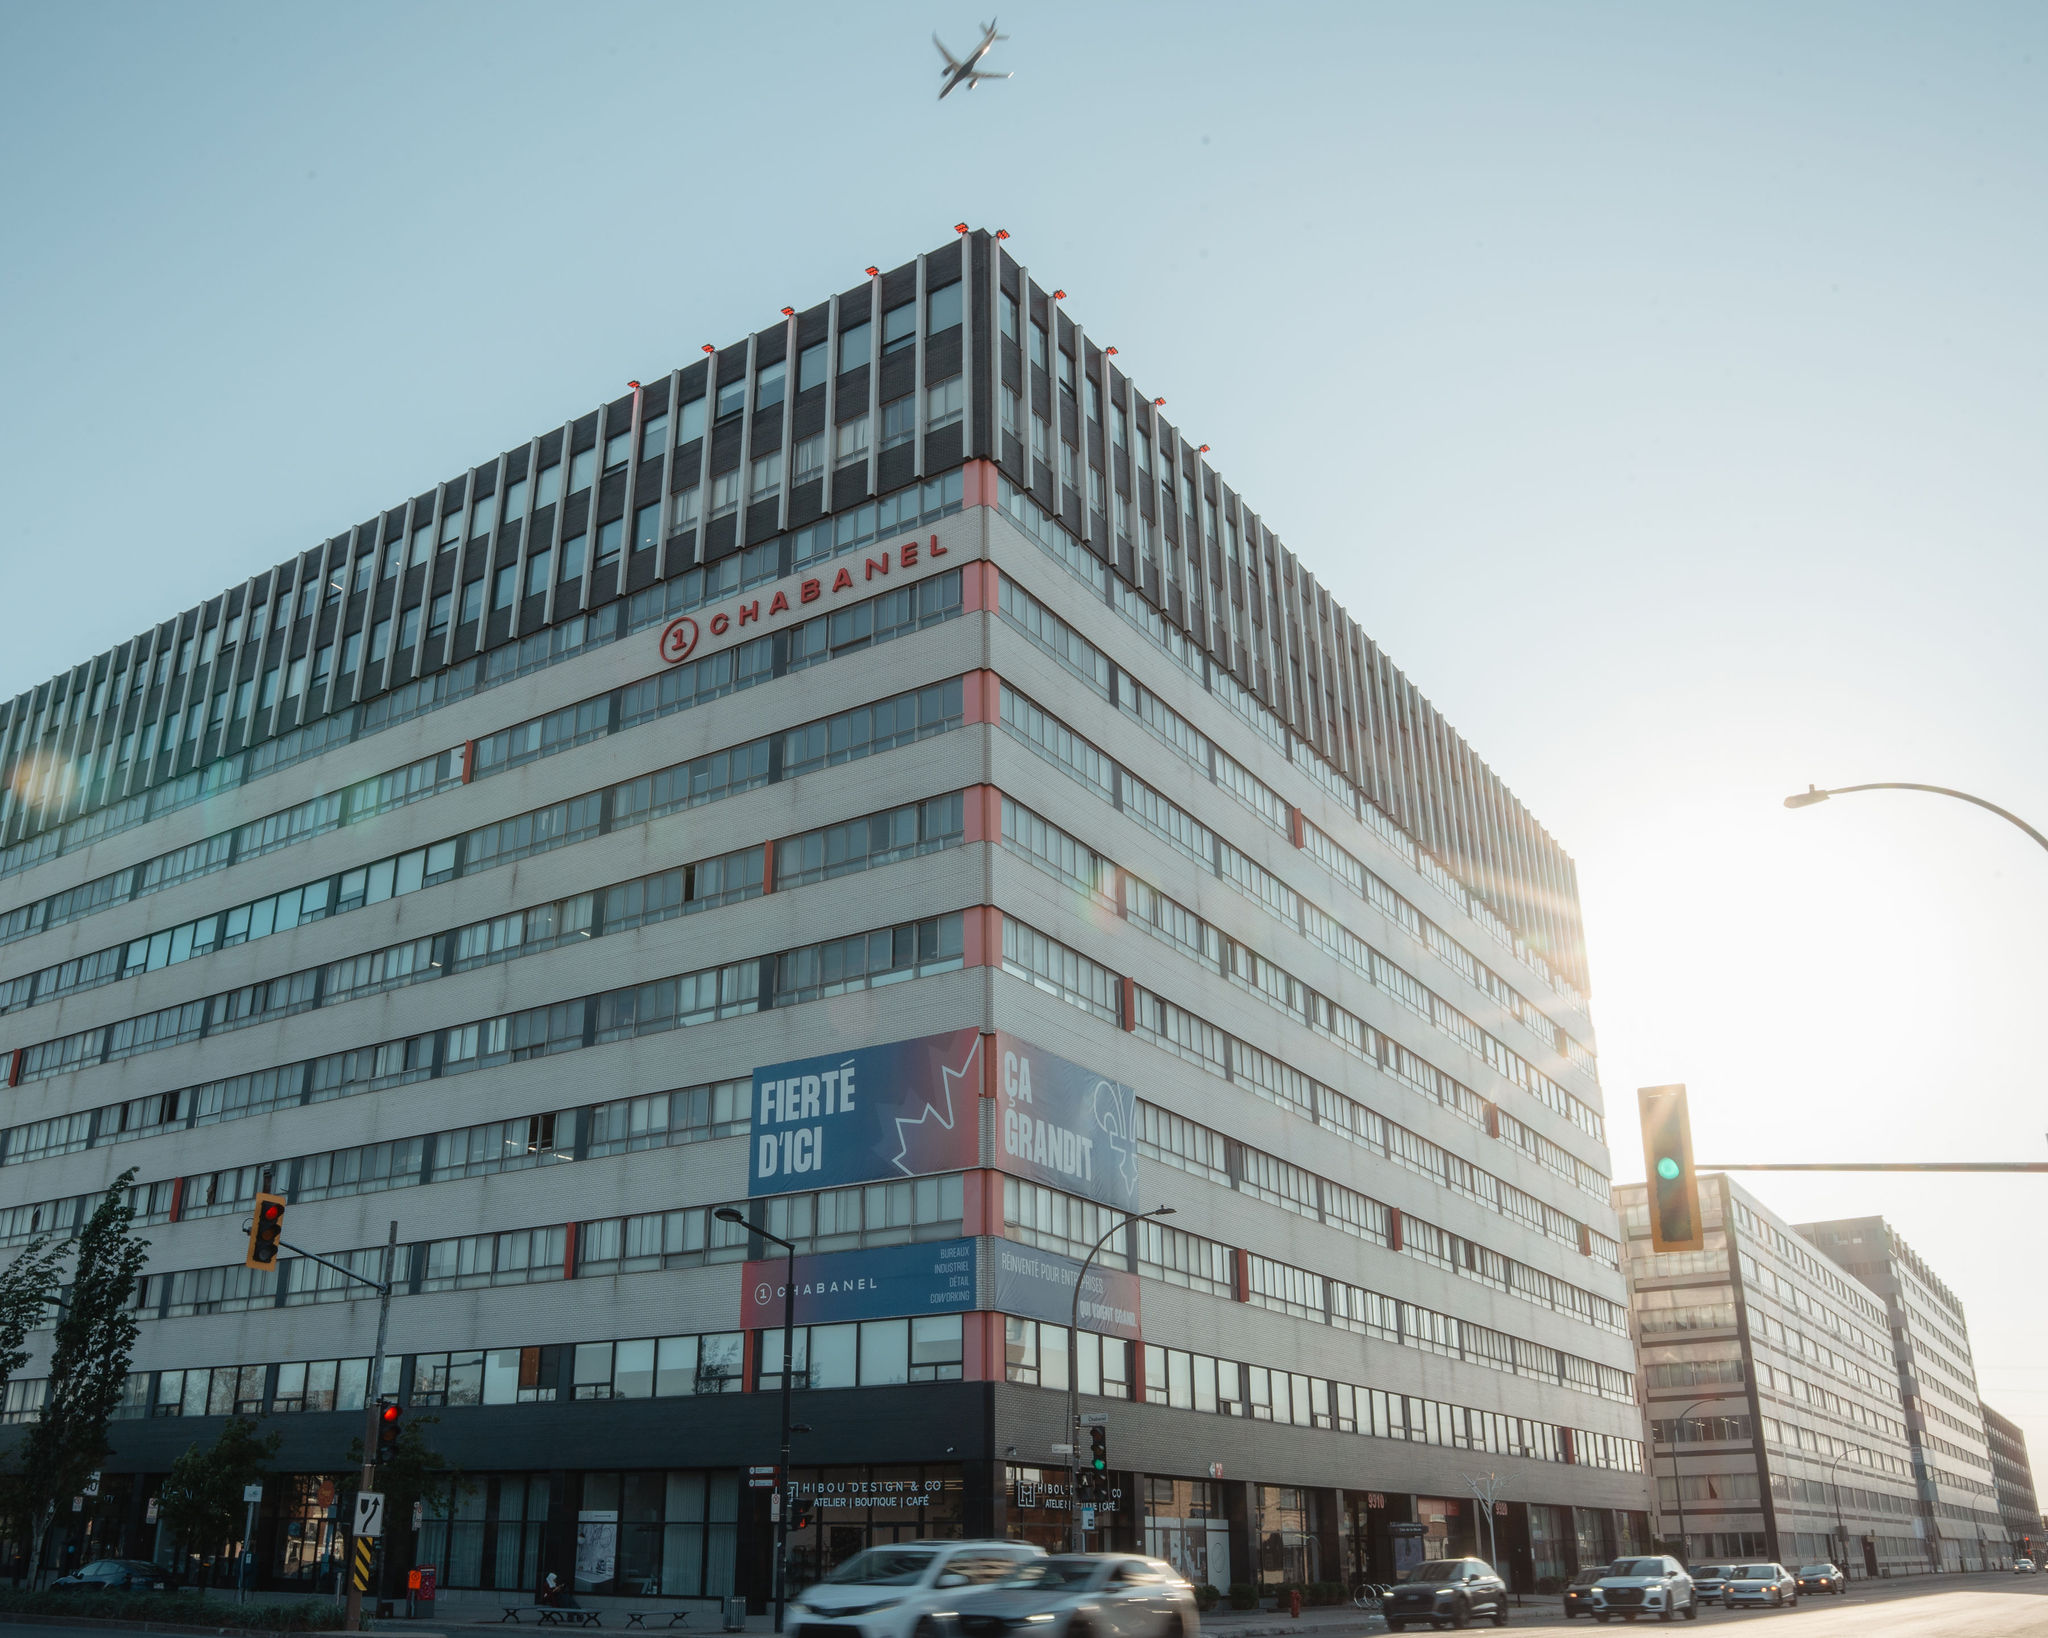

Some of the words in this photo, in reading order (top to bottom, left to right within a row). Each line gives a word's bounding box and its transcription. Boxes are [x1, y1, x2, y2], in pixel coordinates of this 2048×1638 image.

[709, 533, 948, 636] CHABANEL
[1004, 1050, 1033, 1108] ÇA
[760, 1058, 856, 1126] FIERTÉ
[758, 1126, 823, 1178] D'ICI
[1004, 1108, 1094, 1183] GRANDIT
[940, 1246, 970, 1259] BUREAUX
[934, 1261, 969, 1274] INDUSTRIEL
[1001, 1251, 1039, 1279] RÉINVENTÉ
[1041, 1263, 1060, 1283] POUR
[949, 1275, 969, 1287] DÉTAIL
[930, 1290, 970, 1304] COWORKING
[803, 1482, 845, 1493] HIBOU
[852, 1481, 904, 1492] DESIGN
[911, 1481, 918, 1492] &
[925, 1481, 941, 1491] CO
[1111, 1488, 1122, 1498] CO
[813, 1497, 846, 1507] ATELIER
[855, 1497, 897, 1508] BOUTIQUE
[906, 1495, 929, 1506] CAFÉ
[1102, 1501, 1116, 1511] CAFÉ
[1368, 1494, 1385, 1509] 9310
